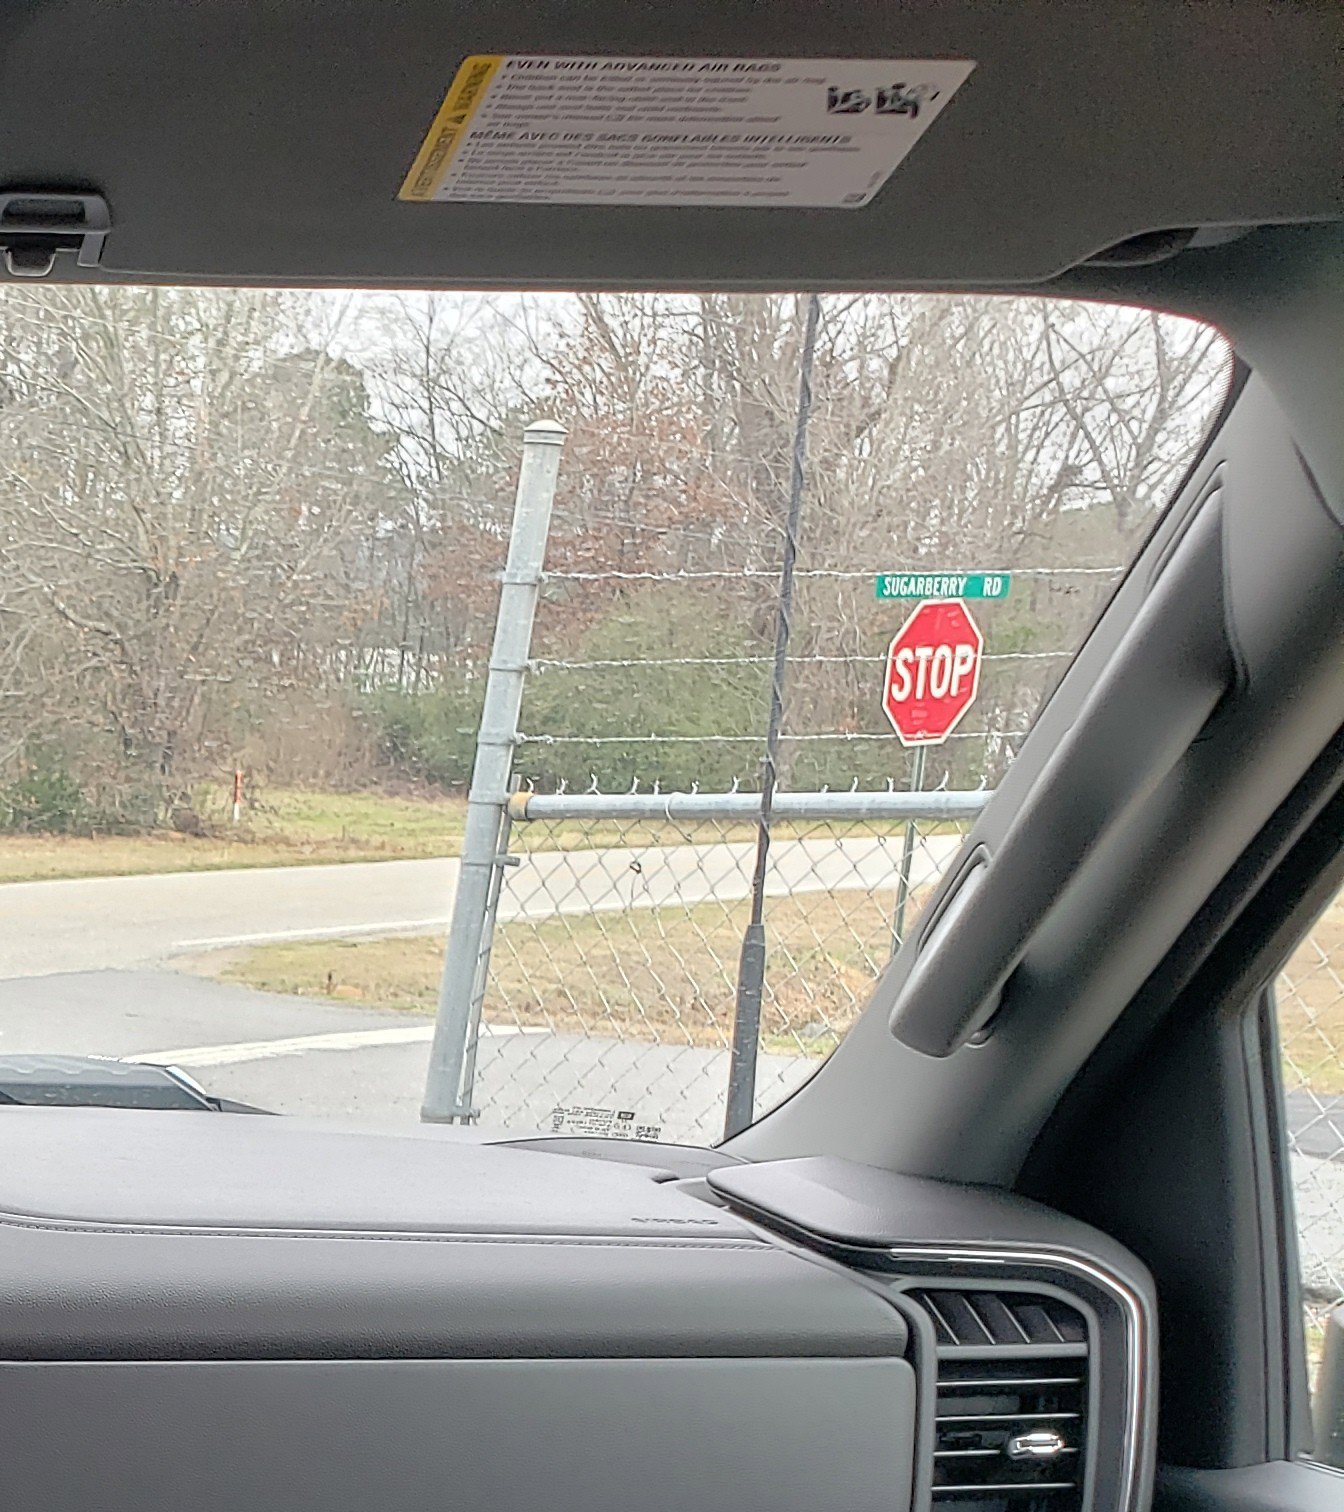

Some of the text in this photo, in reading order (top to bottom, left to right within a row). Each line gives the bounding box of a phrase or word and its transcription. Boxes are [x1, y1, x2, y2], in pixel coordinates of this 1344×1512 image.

[883, 577, 1002, 595] SUGARBERRY RD
[891, 644, 975, 702] STOP
